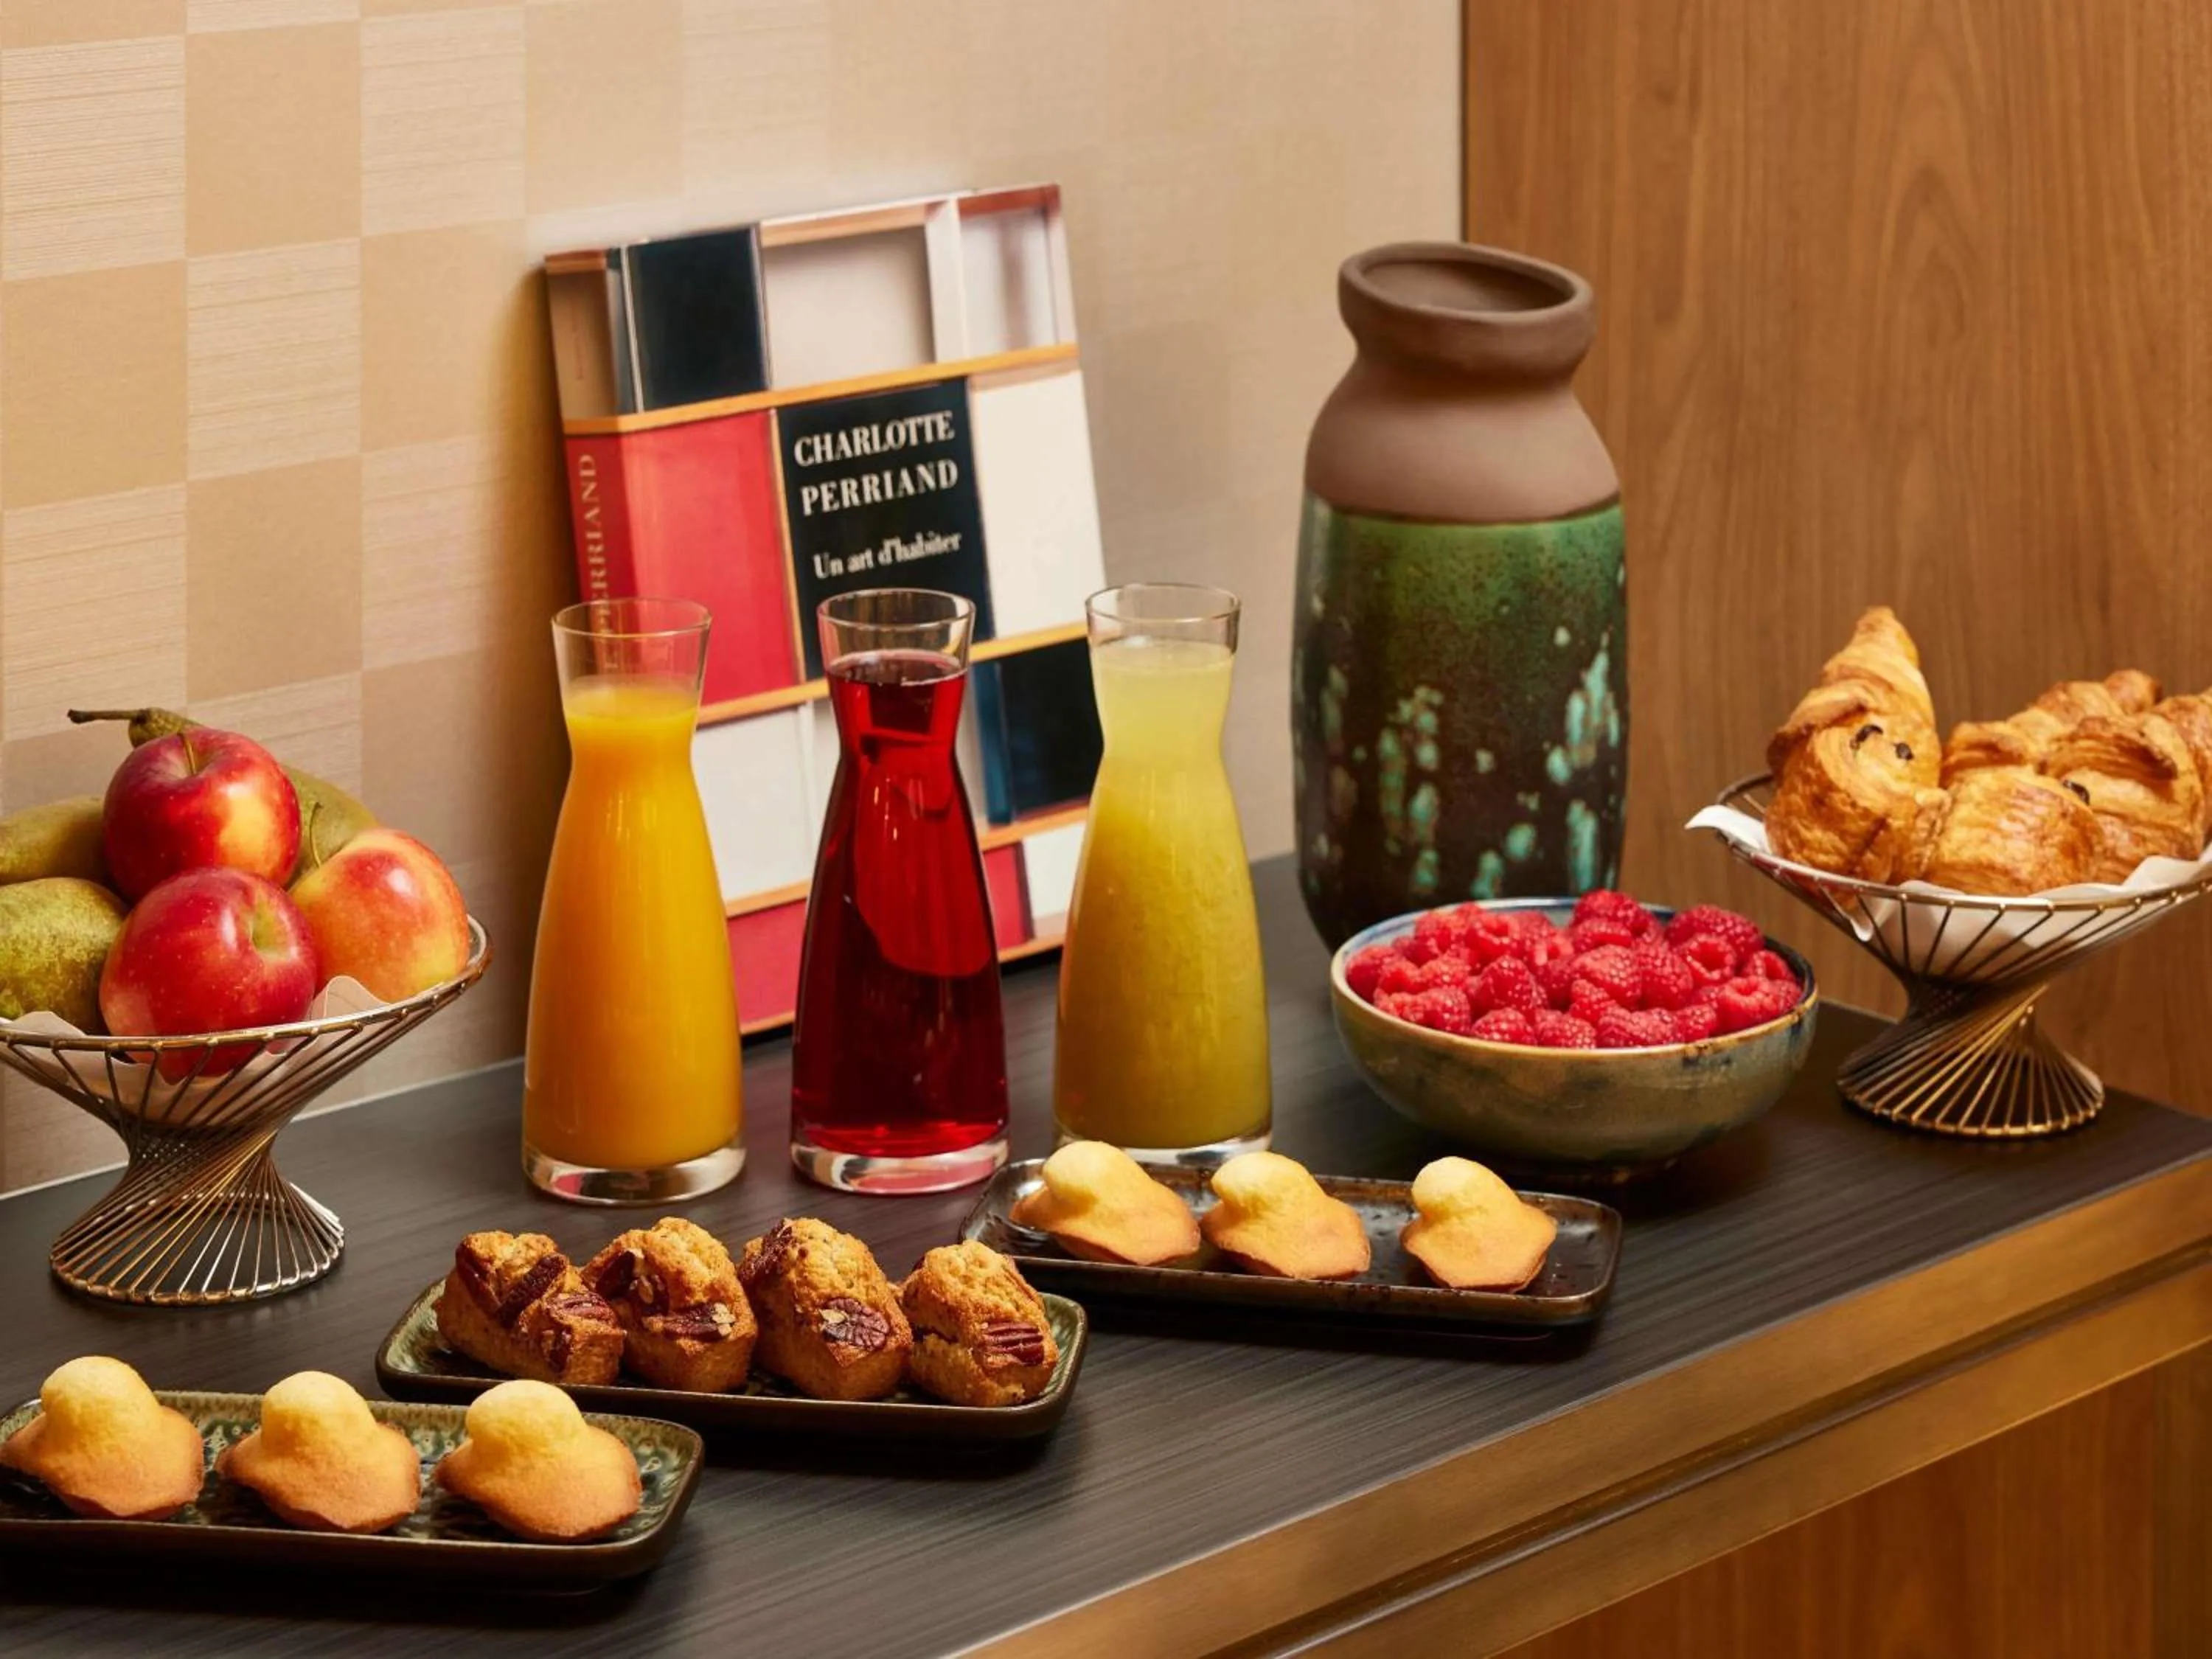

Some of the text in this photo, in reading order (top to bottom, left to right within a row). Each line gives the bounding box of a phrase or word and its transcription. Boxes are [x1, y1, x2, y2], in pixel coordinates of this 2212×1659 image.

[793, 410, 956, 467] CHARLOTTE
[800, 459, 959, 516] PERRIAND
[813, 552, 844, 579] Un
[848, 549, 874, 572] art
